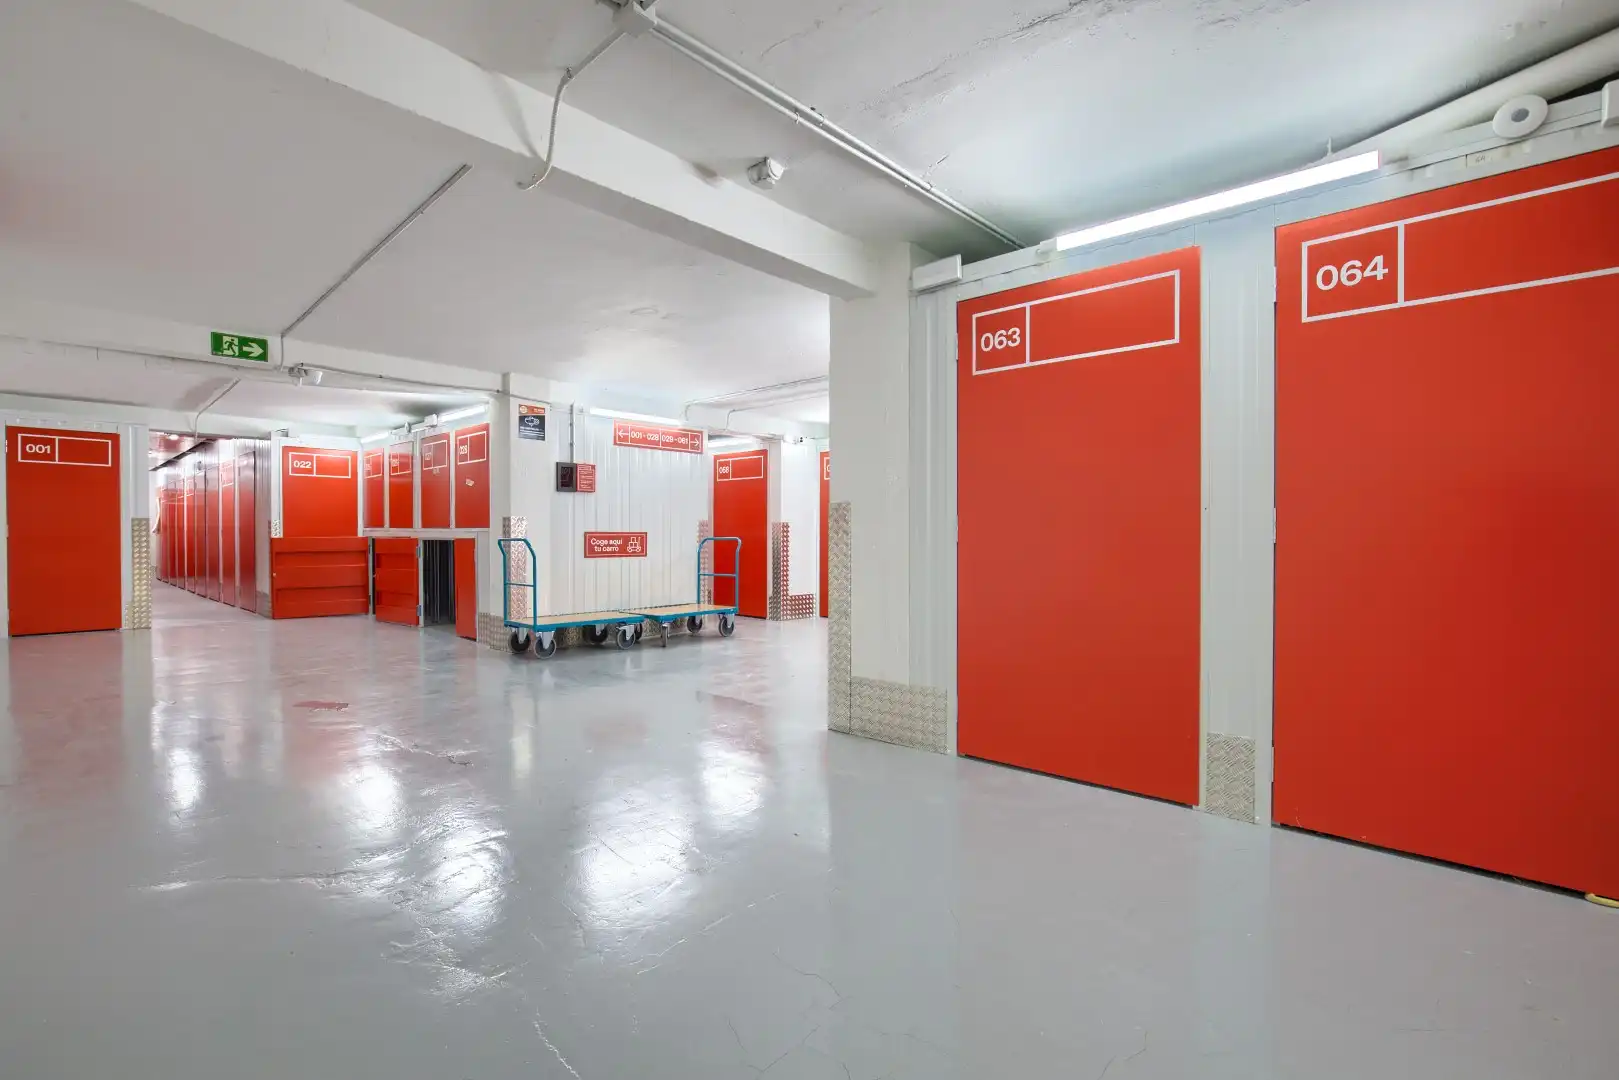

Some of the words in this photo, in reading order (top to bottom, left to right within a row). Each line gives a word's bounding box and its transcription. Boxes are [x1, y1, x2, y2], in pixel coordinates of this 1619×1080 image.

[1316, 254, 1389, 291] 064
[980, 327, 1021, 352] 063
[25, 443, 51, 454] 001
[293, 460, 312, 469] 022
[590, 537, 608, 547] Coge
